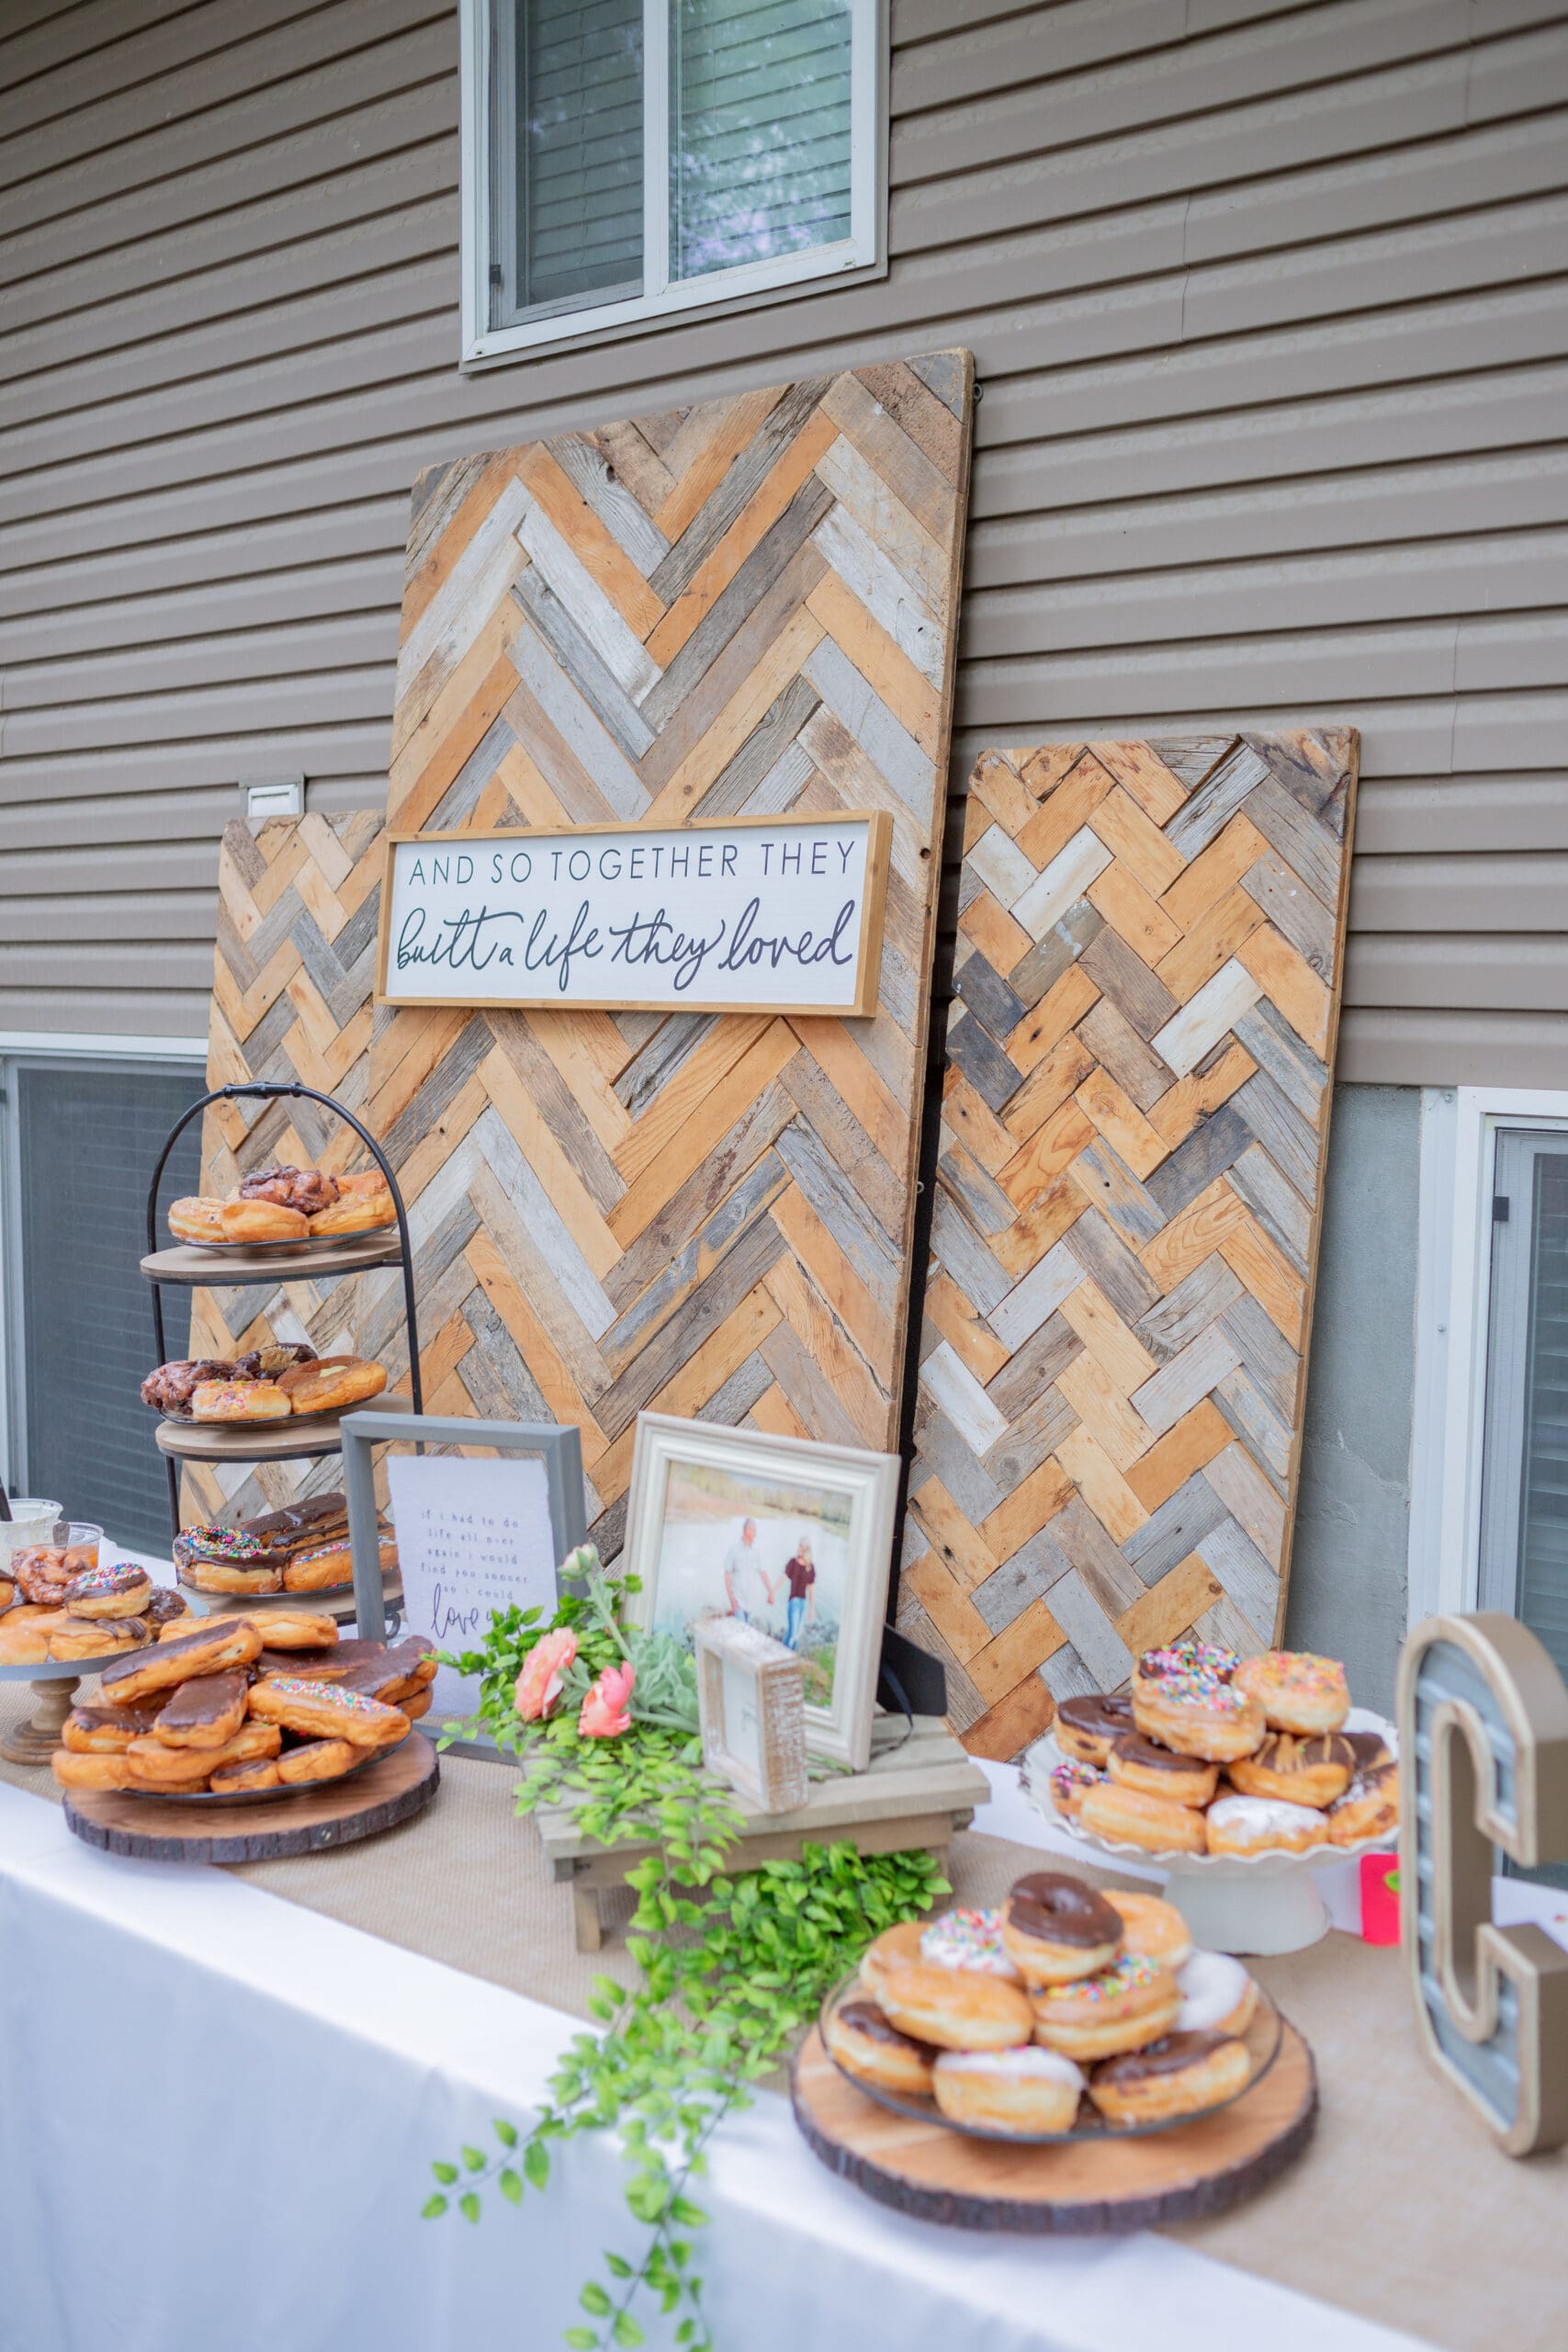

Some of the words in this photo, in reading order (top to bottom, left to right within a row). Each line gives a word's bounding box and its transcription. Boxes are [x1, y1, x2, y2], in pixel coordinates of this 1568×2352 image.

[408, 854, 475, 886] AND
[490, 852, 533, 884] SO
[550, 843, 739, 882] TOGETHER
[760, 840, 856, 876] THEY
[396, 904, 525, 971] built
[498, 945, 514, 967] a
[525, 899, 604, 992] life
[608, 908, 727, 991] they
[717, 897, 856, 972] loved
[421, 1509, 431, 1521] if
[451, 1511, 473, 1524] had
[481, 1516, 494, 1526] to
[502, 1518, 518, 1528] do
[428, 1528, 451, 1540] life
[460, 1532, 478, 1543] all
[427, 1548, 460, 1558] again
[480, 1554, 518, 1566] would
[421, 1561, 446, 1575] find
[455, 1568, 476, 1578] you
[444, 1585, 457, 1594] so
[477, 1589, 513, 1600] could
[430, 1582, 479, 1639] love
[1397, 1612, 1564, 2157] C
